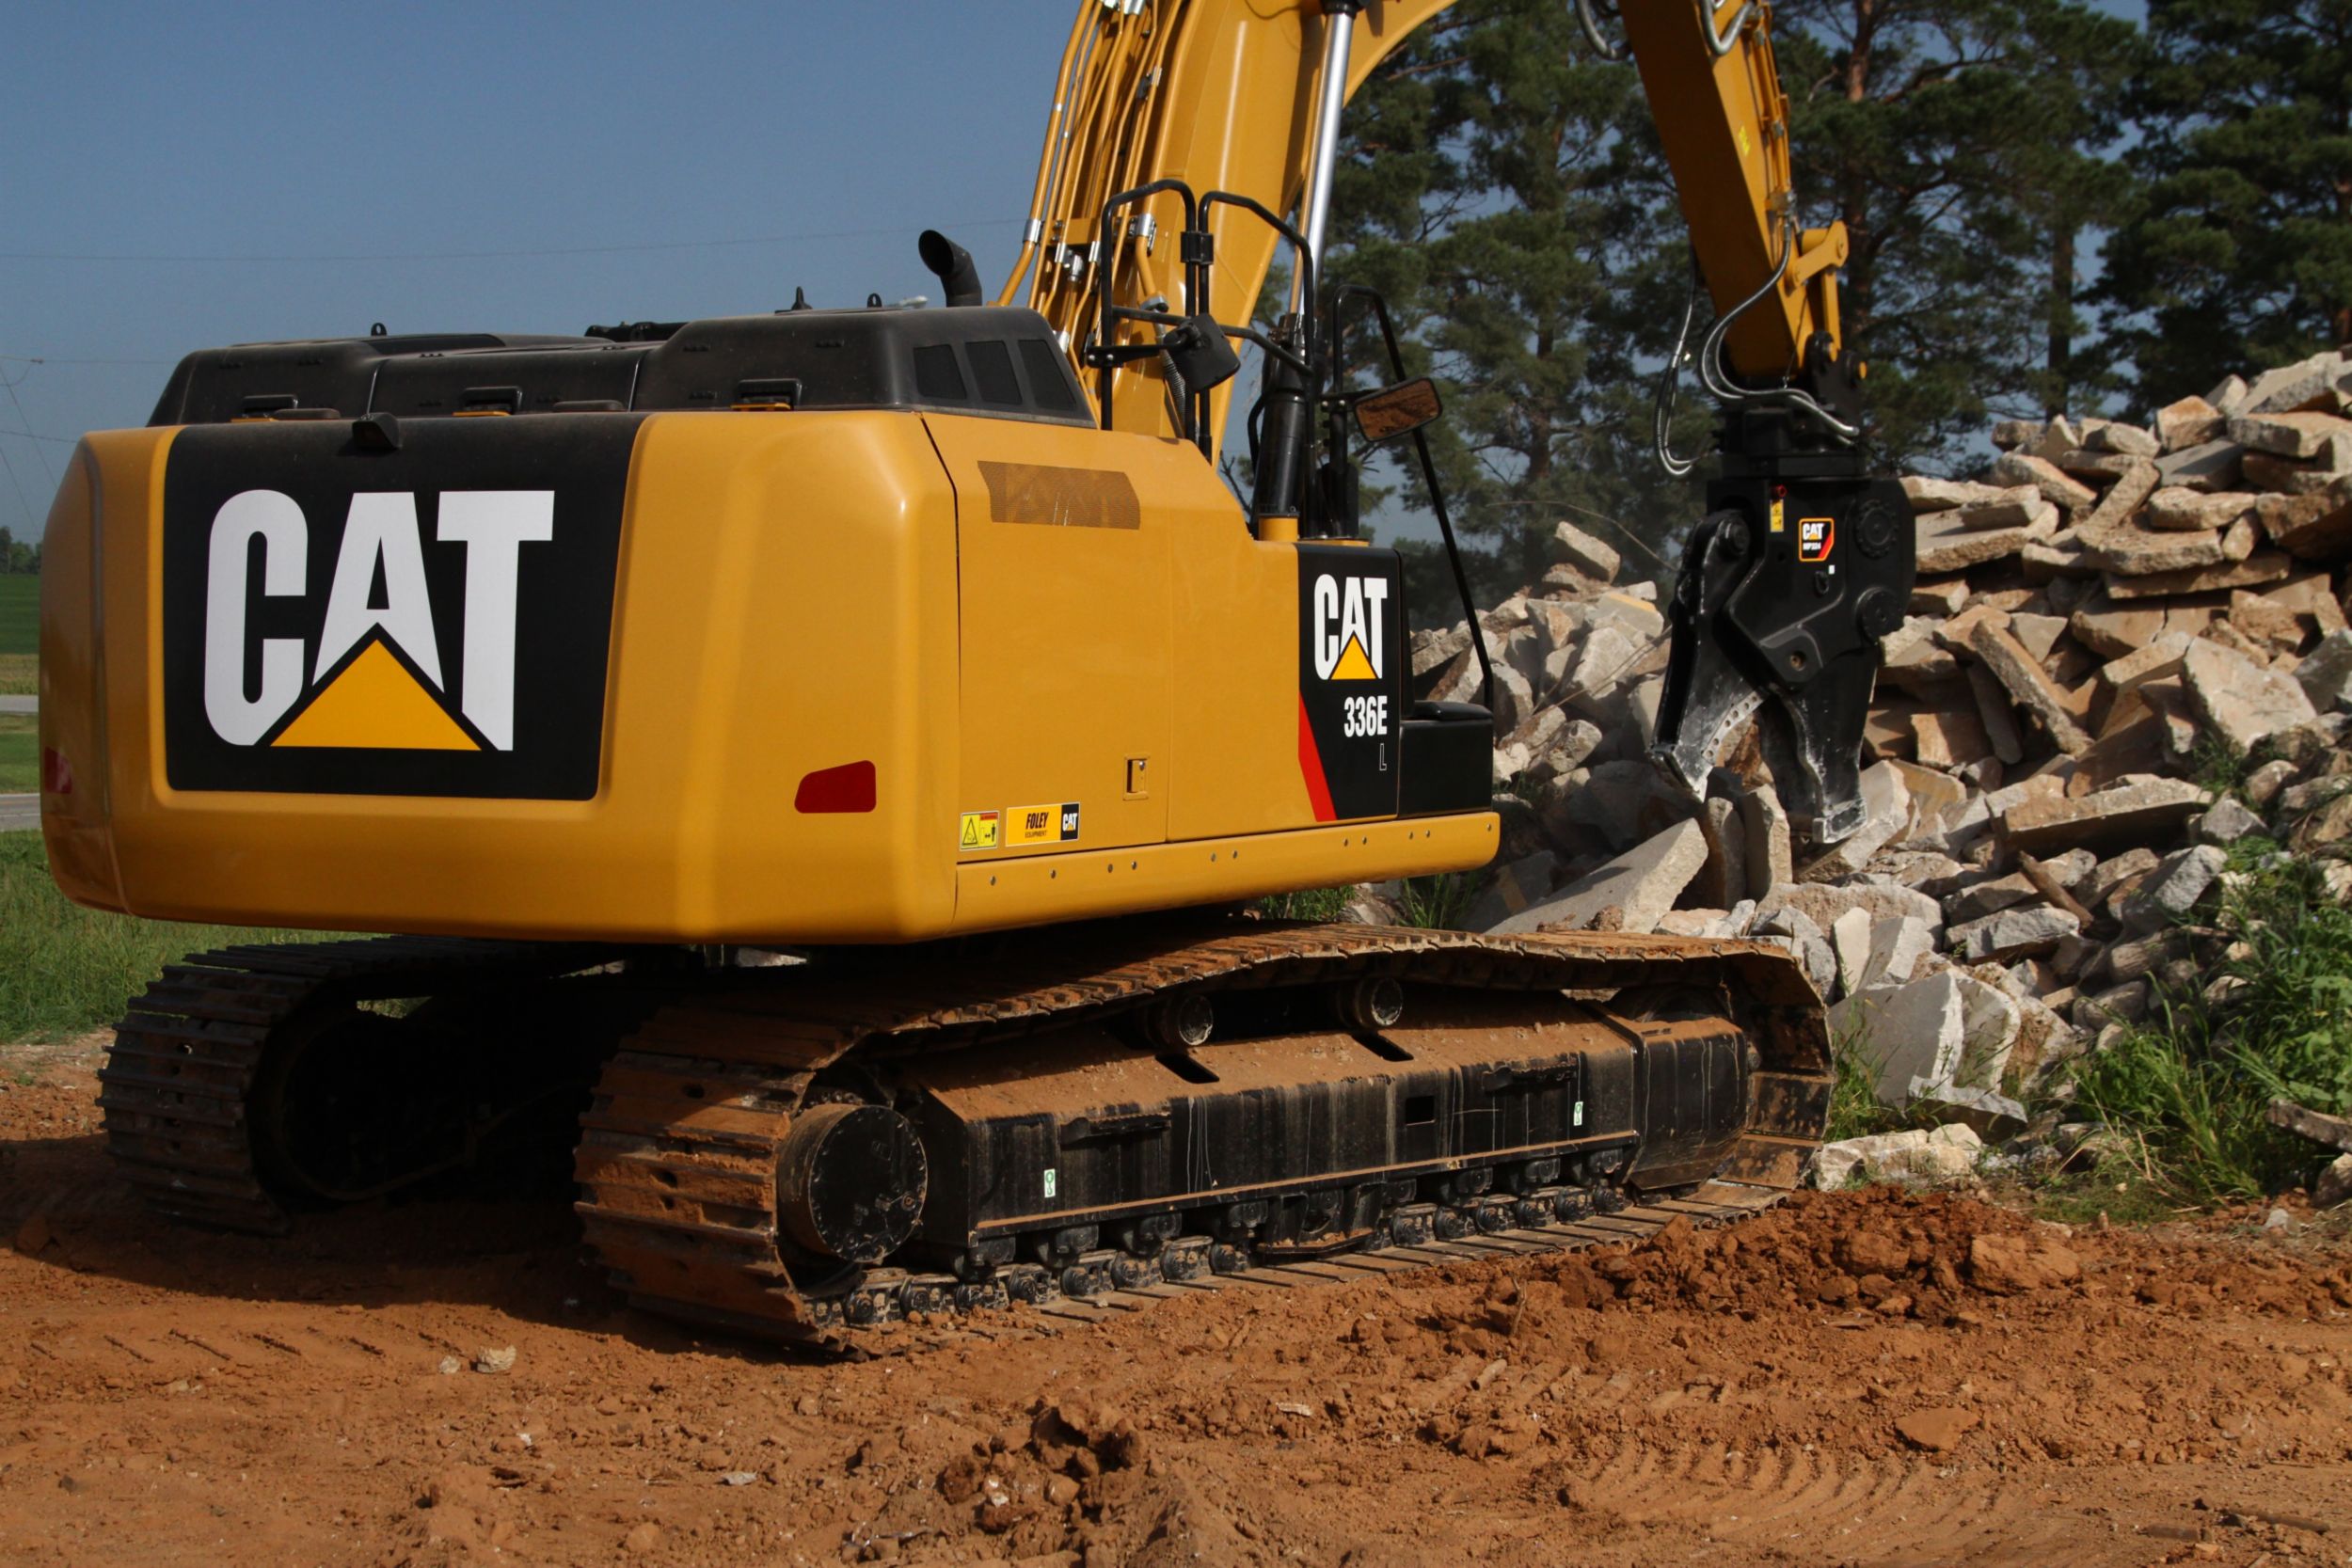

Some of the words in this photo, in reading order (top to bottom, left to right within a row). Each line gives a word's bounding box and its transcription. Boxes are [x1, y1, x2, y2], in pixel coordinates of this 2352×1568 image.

[1803, 523, 1824, 541] CAT
[204, 489, 555, 751] CAT
[1314, 574, 1388, 680] CAT
[1343, 695, 1388, 737] 336E
[1025, 812, 1049, 830] FOLEY
[1062, 813, 1078, 832] CAT
